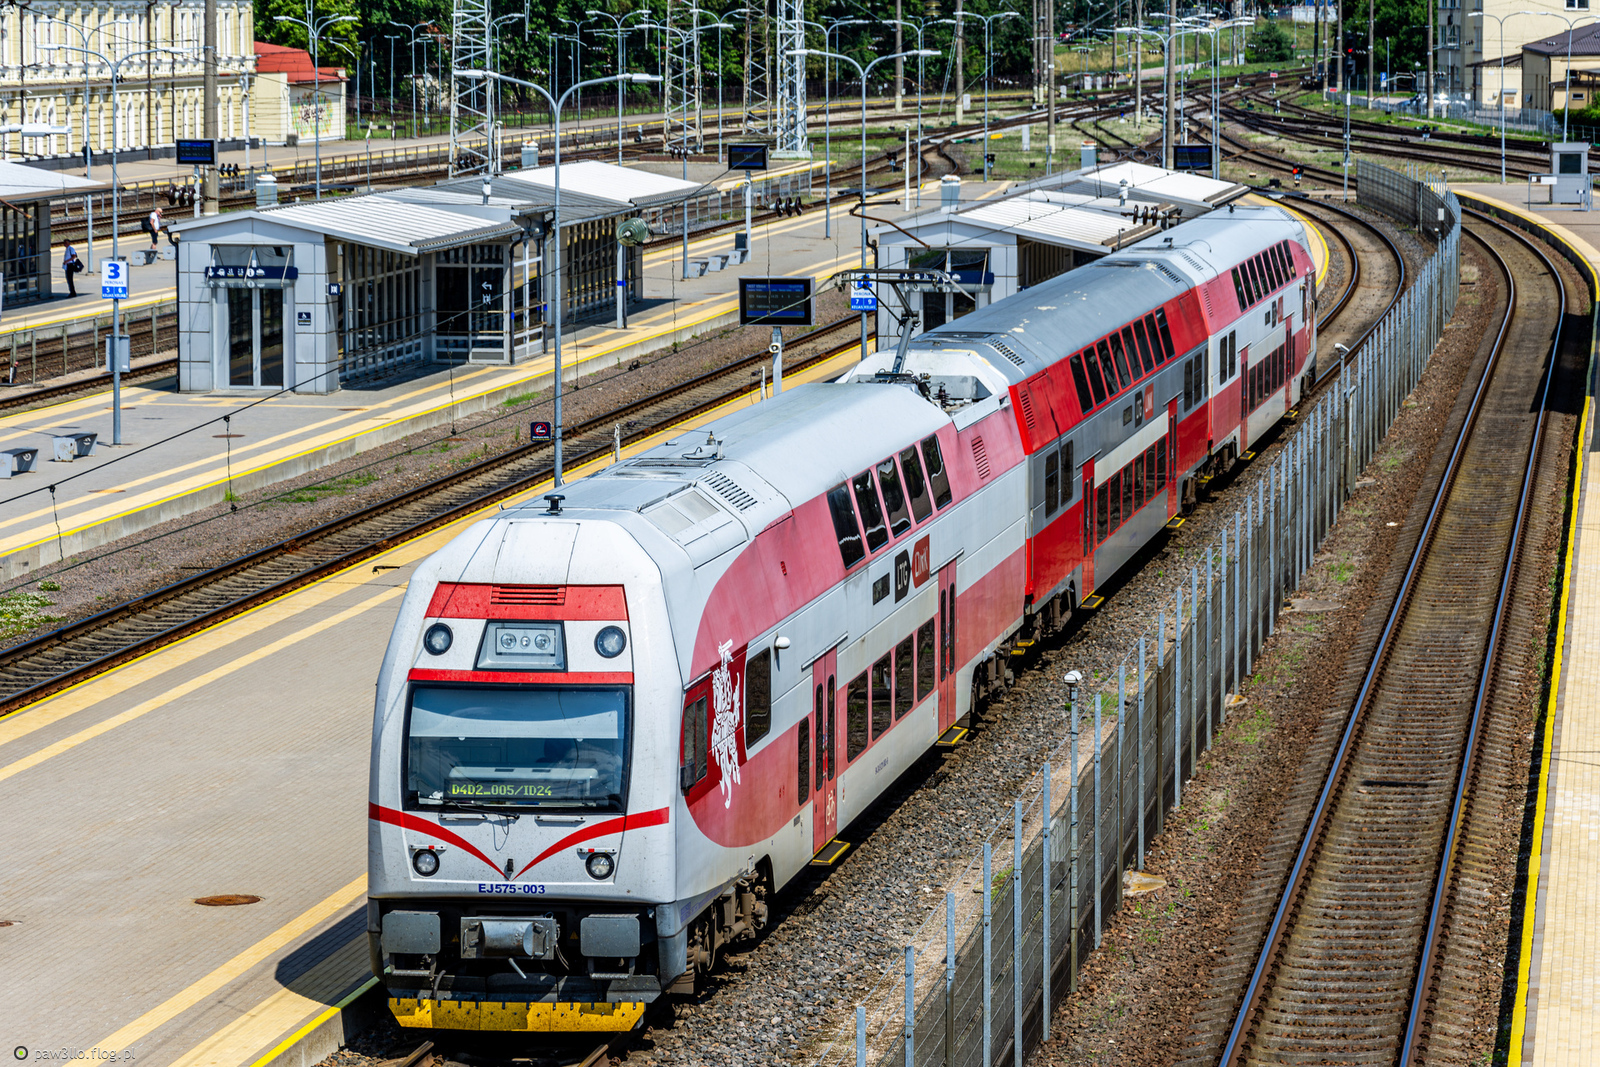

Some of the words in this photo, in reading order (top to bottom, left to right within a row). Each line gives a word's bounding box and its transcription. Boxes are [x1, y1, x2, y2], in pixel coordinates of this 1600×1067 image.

[108, 263, 120, 279] 3
[897, 560, 908, 590] LTG
[478, 883, 546, 894] EJ575-003
